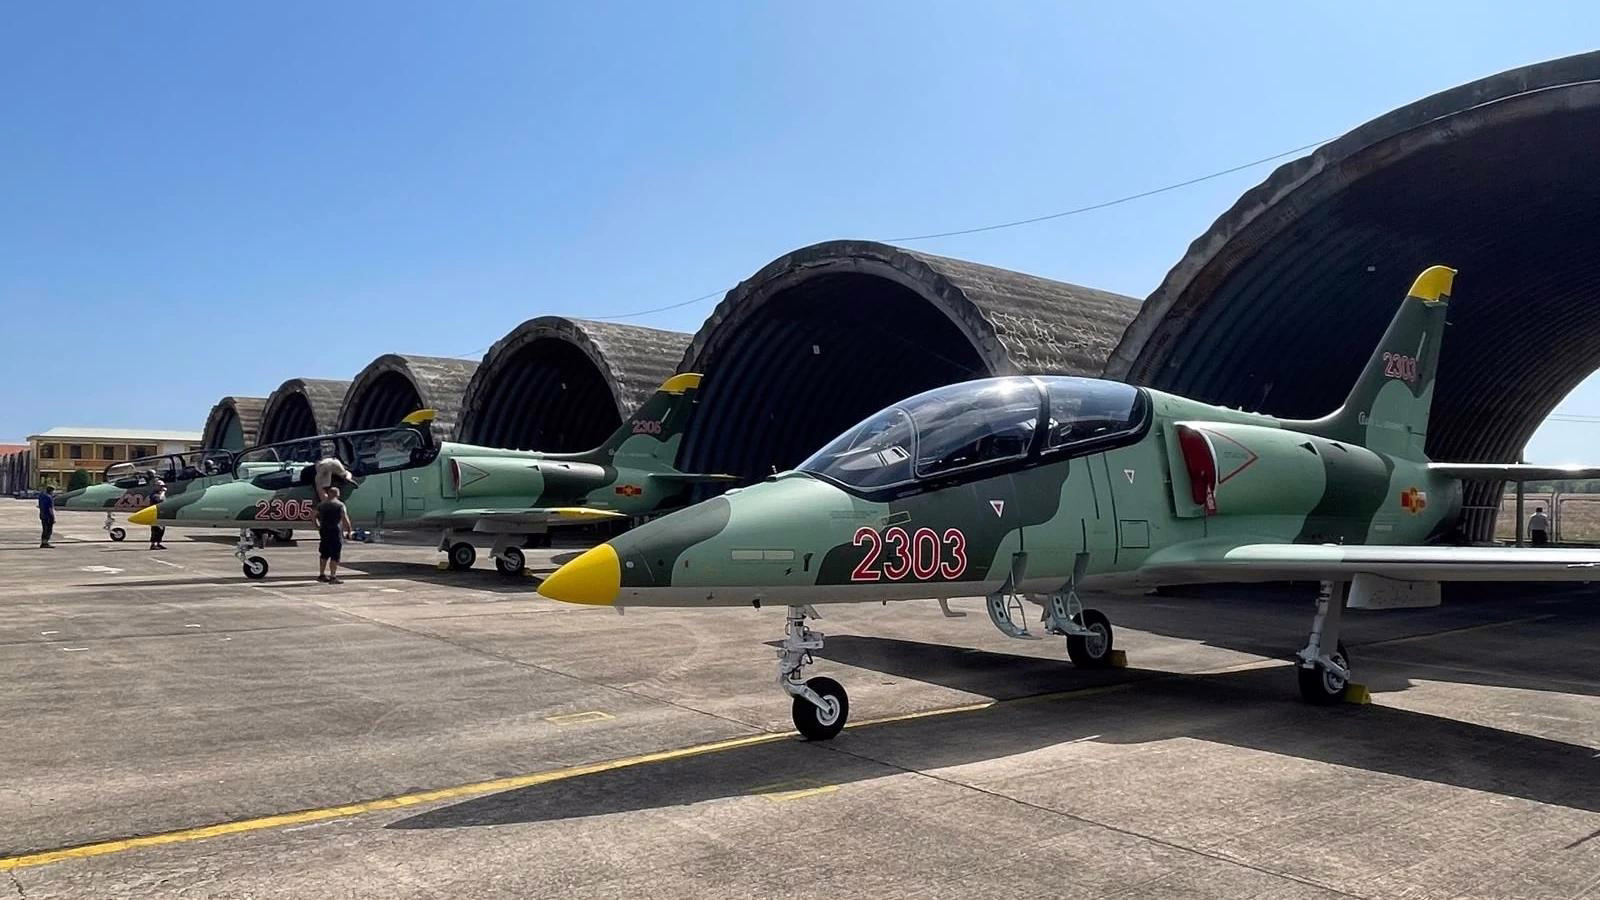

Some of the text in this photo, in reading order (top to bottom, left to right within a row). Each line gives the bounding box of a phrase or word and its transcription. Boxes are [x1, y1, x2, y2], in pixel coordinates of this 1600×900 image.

[1383, 352, 1416, 382] 2303
[255, 499, 313, 521] 2305
[851, 526, 967, 580] 2303
